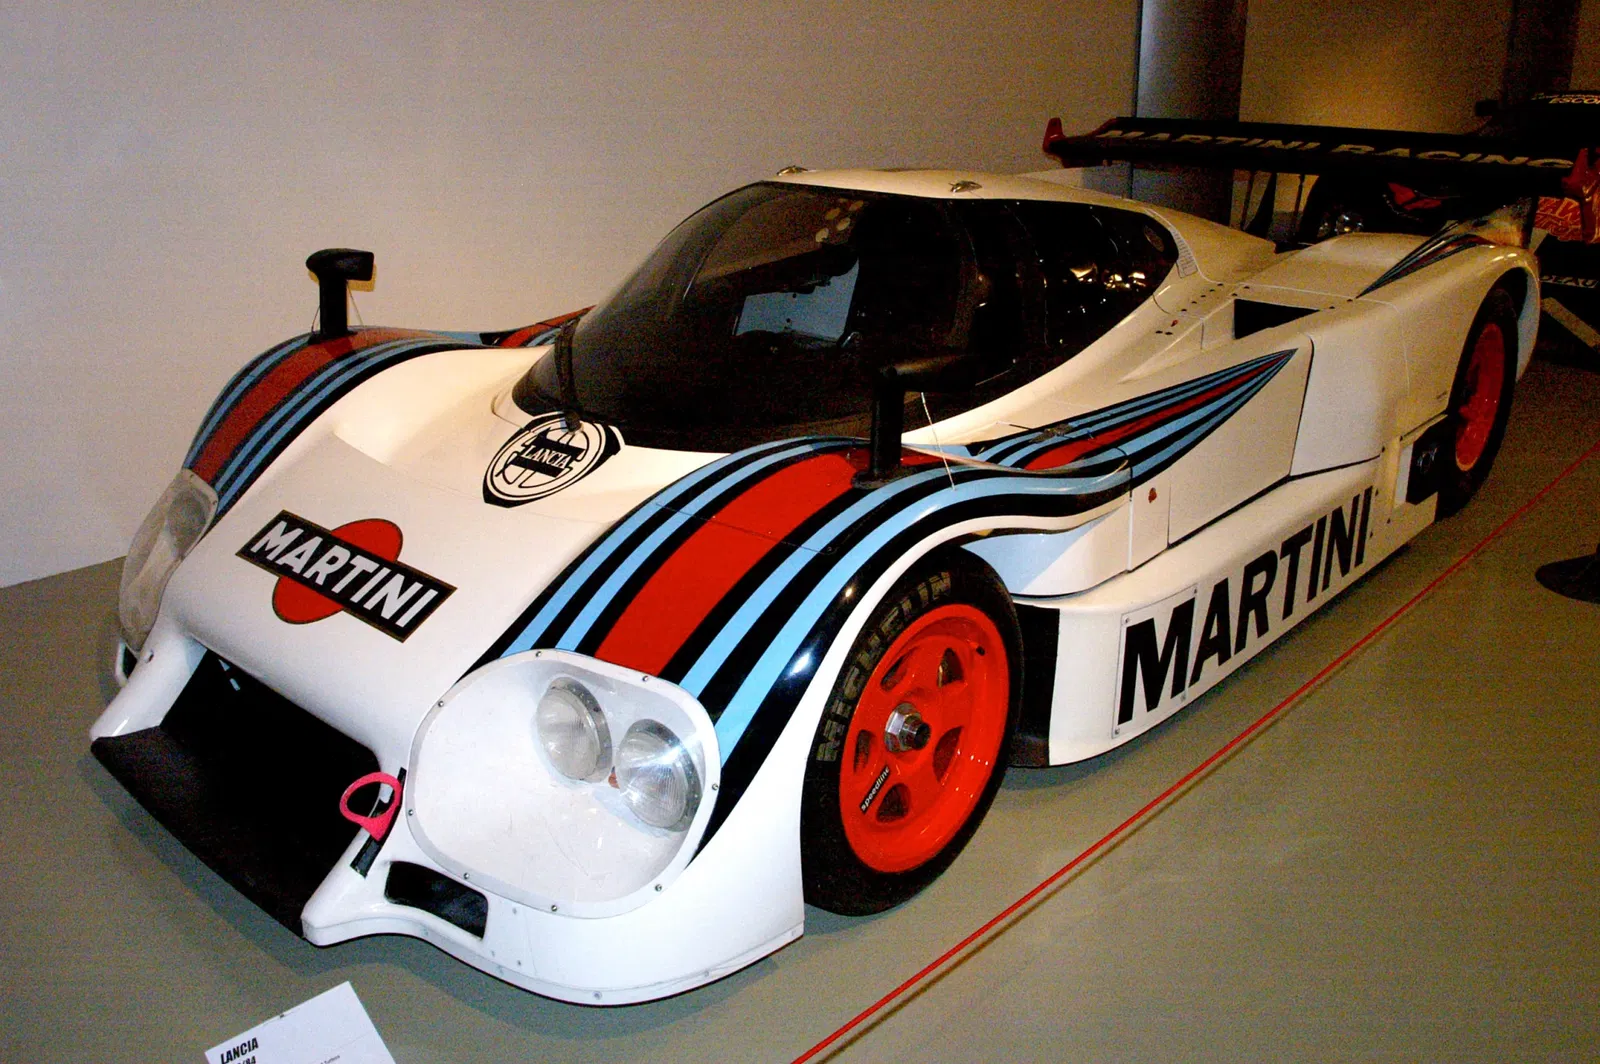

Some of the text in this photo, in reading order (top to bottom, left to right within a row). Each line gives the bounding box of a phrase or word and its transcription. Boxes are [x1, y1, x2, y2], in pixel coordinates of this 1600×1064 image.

[521, 445, 572, 469] LANCIA
[250, 520, 439, 628] MARTINI
[1117, 485, 1373, 726] MARTINI
[816, 571, 951, 761] MICHELIN
[861, 766, 890, 811] speedline
[220, 1037, 259, 1064] LANCIA
